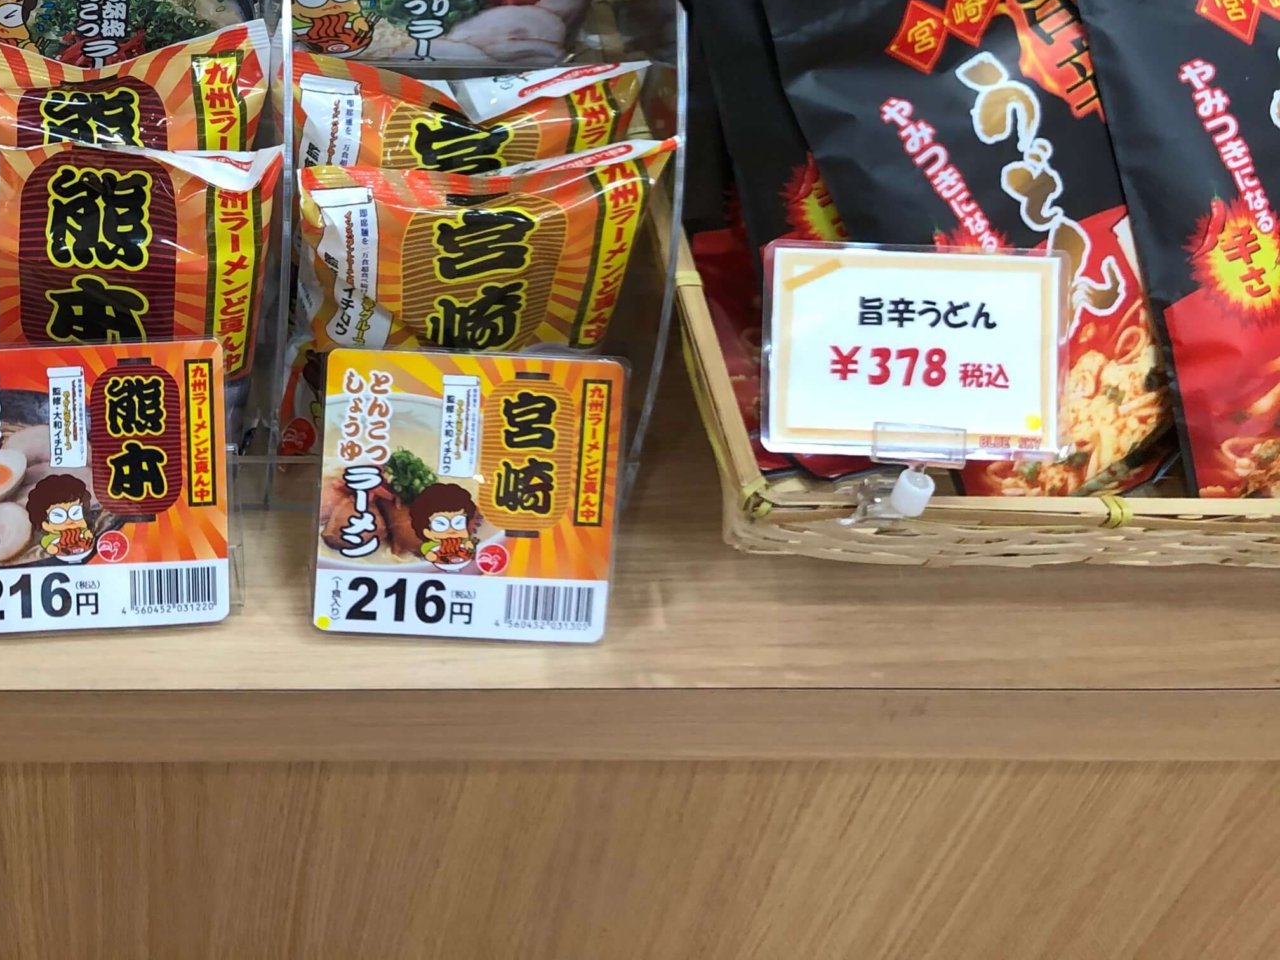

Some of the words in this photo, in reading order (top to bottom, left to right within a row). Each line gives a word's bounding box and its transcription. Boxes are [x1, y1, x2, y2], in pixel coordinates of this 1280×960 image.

[1179, 59, 1275, 234] やみつきになる
[48, 166, 151, 344] 熊本
[429, 208, 538, 352] 宮崎
[858, 296, 998, 330] 旨辛うどん
[1222, 226, 1272, 299] 辛さ
[106, 376, 166, 499] 熊本
[190, 365, 211, 502] 九州ラーメンど真ん中
[339, 371, 364, 462] しょうゆ
[364, 371, 392, 464] とんこつ
[958, 363, 1011, 390] 税込
[341, 464, 383, 558] ラーメン
[495, 392, 557, 514] 宮崎
[580, 385, 605, 521] 九州ラーメンど真ん中
